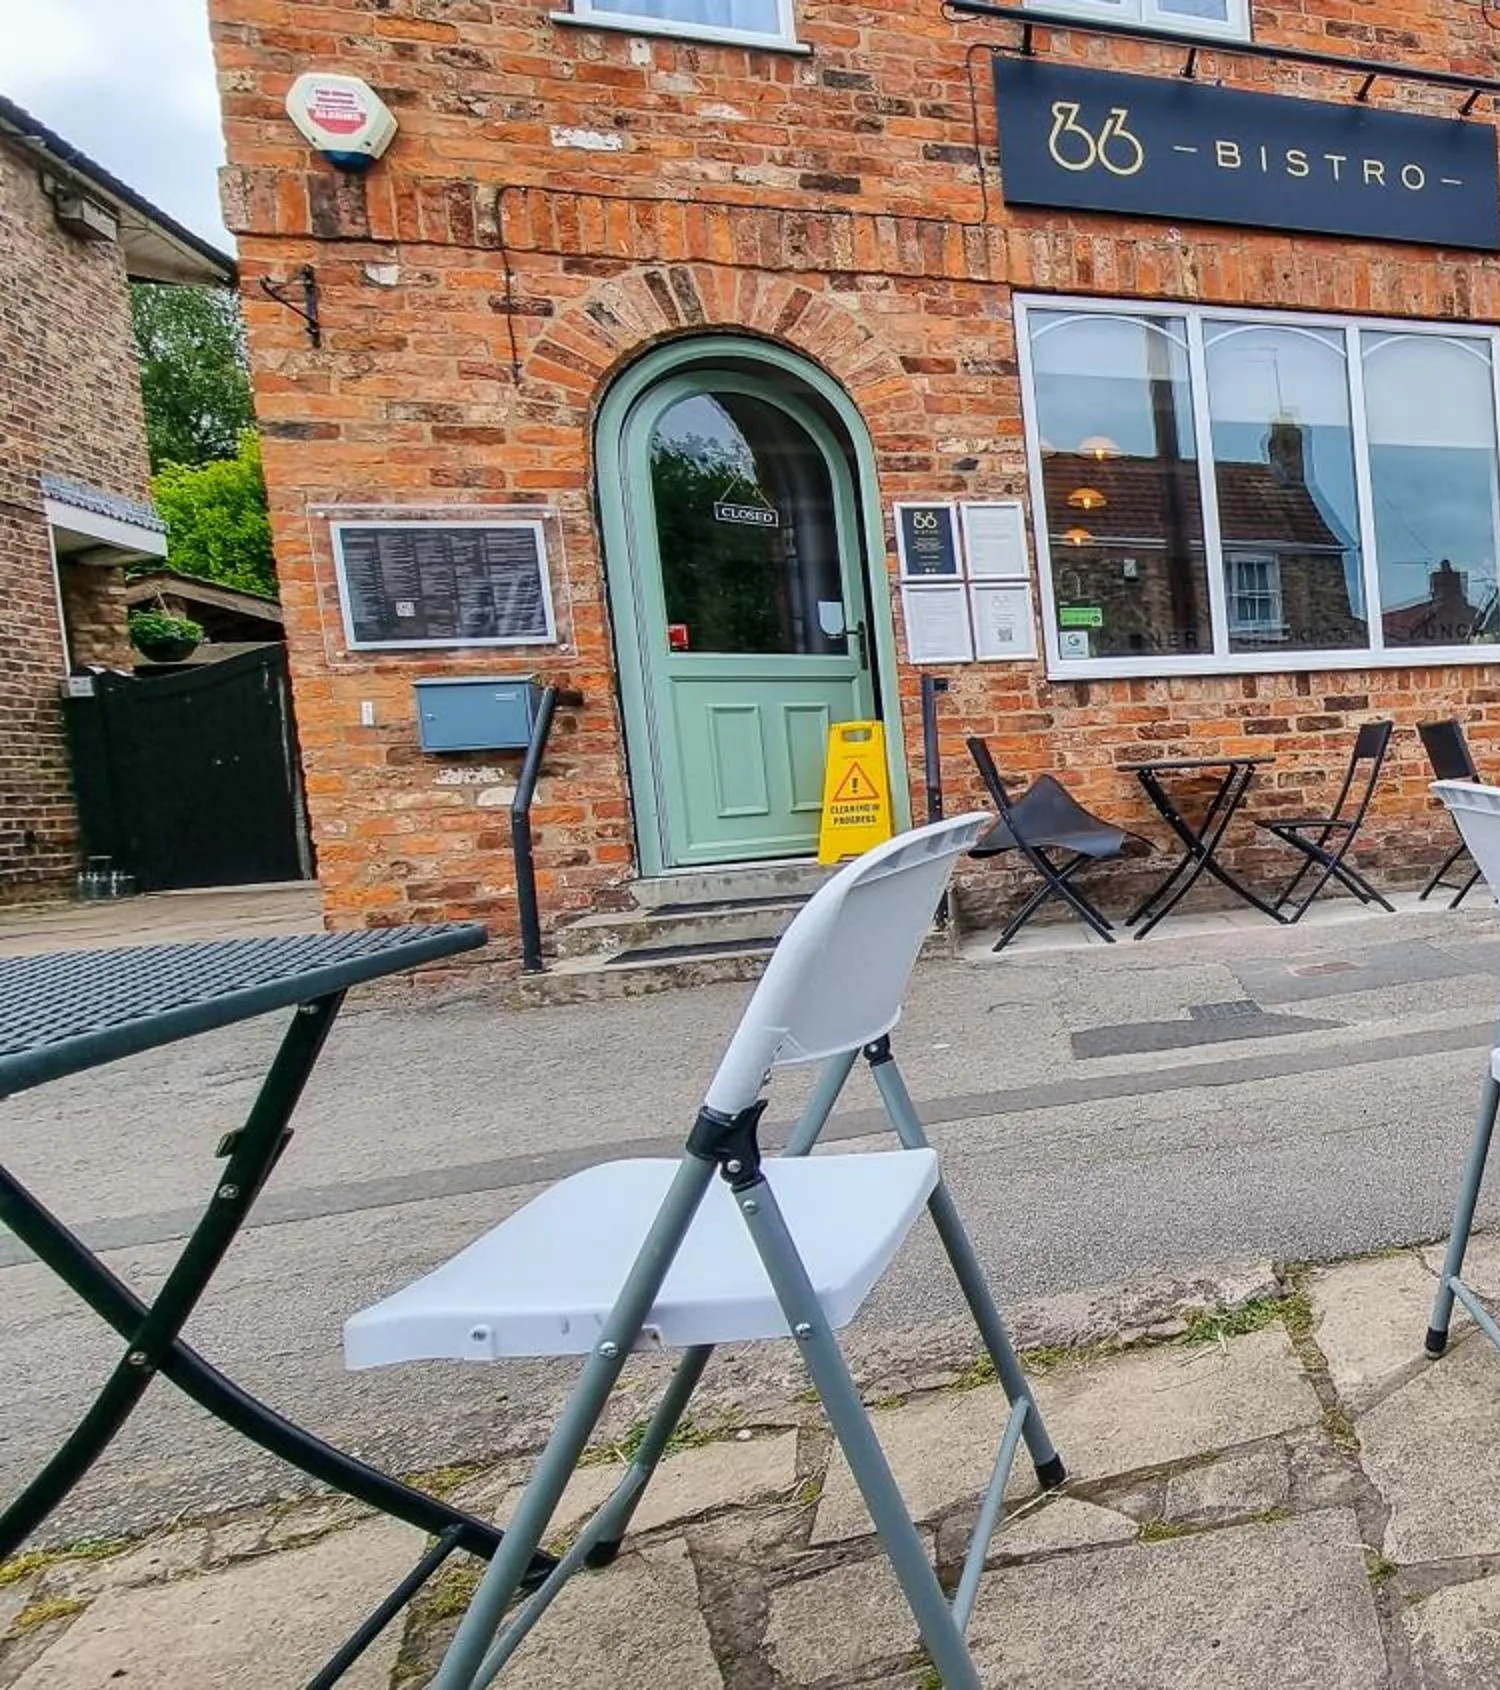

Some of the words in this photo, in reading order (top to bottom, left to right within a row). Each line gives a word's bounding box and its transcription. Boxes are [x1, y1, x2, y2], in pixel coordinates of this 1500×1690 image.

[1215, 140, 1425, 190] BISTRO
[721, 507, 773, 523] CLOSED
[830, 804, 870, 815] CLEANING
[833, 815, 877, 825] PROGRESS
